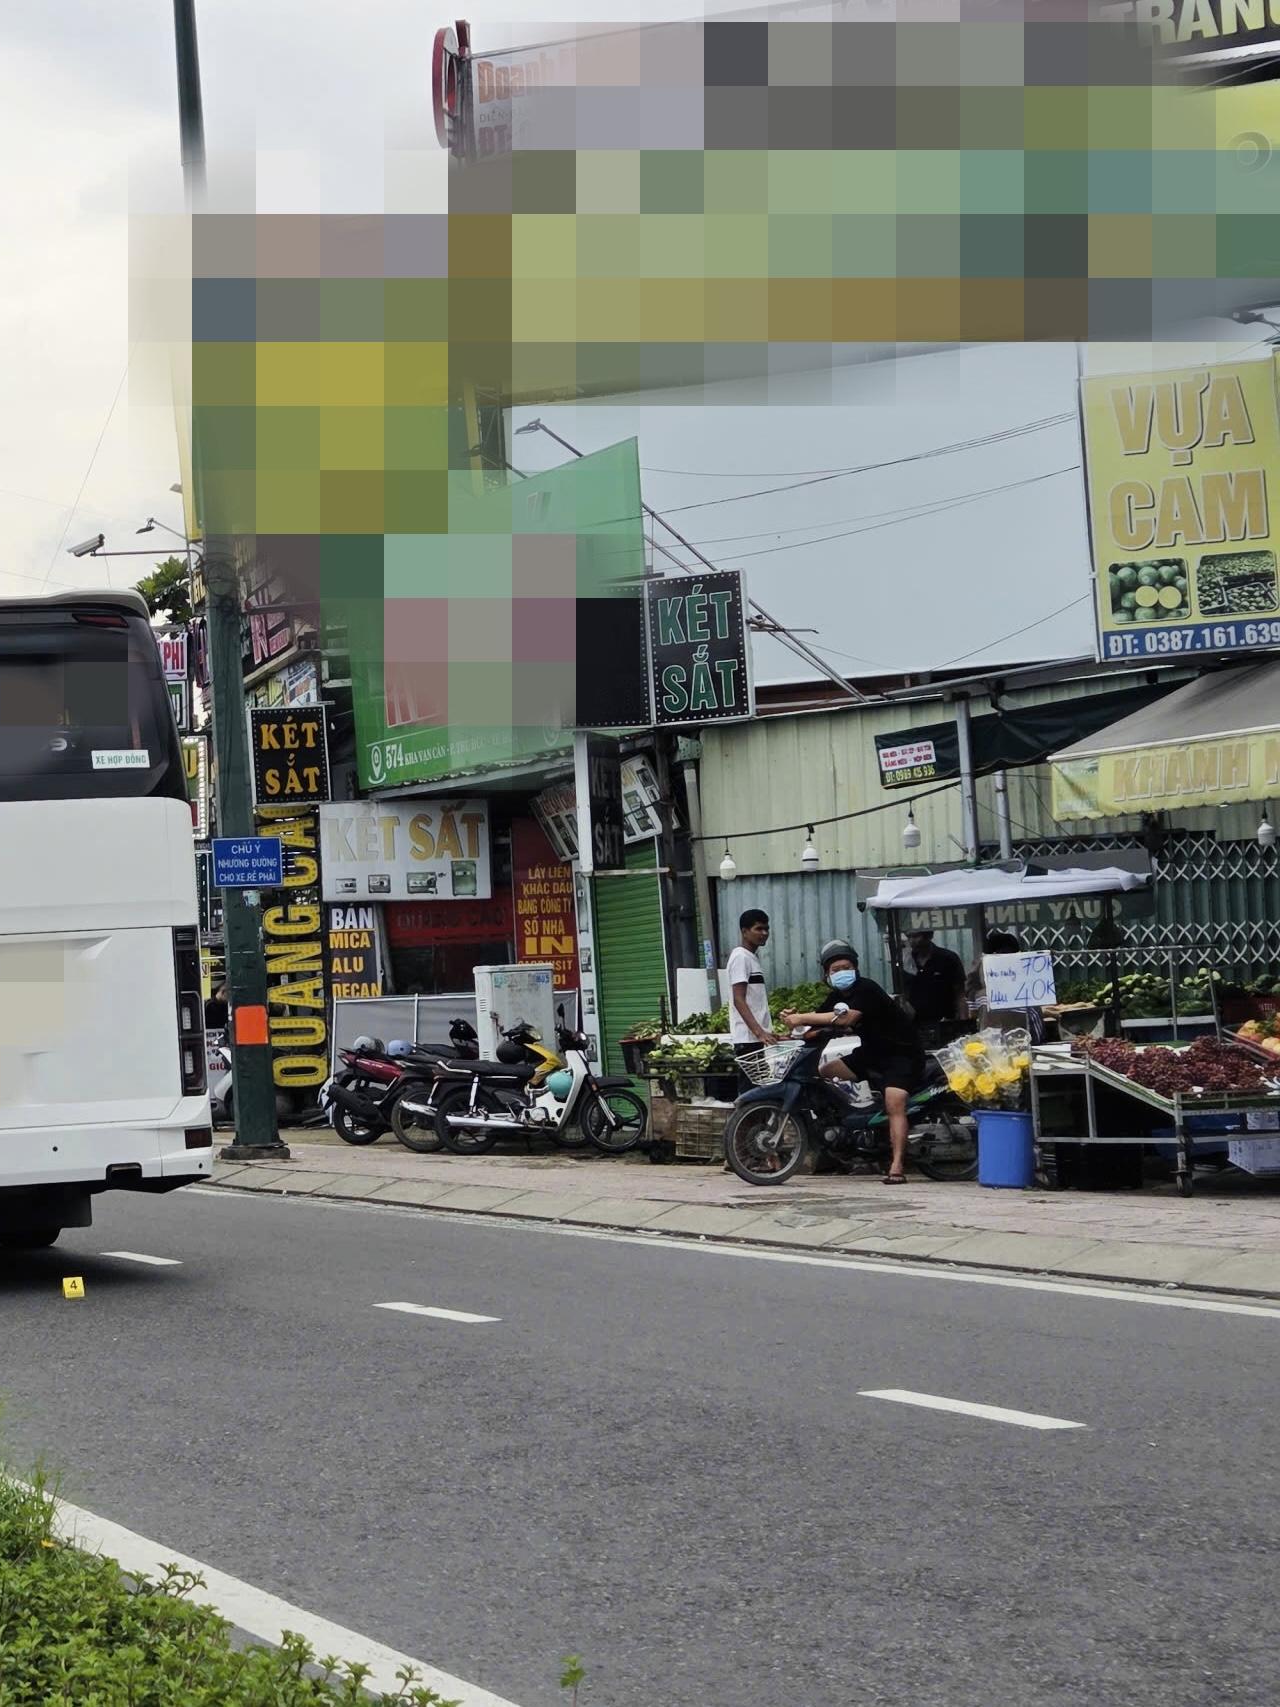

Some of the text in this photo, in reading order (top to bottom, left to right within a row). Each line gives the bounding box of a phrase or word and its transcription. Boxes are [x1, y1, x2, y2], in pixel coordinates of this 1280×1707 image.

[1110, 371, 1255, 466] VỰA
[1109, 468, 1269, 551] CAM
[657, 584, 732, 646] KÉT
[1109, 620, 1280, 656] ĐT: 0387.161.639
[662, 644, 738, 713] SẮT
[260, 715, 319, 751] KÉT
[385, 742, 404, 769] 574
[264, 753, 320, 795] SẮT
[408, 801, 485, 861] SẮT
[219, 872, 235, 883] CHO
[331, 903, 374, 930] BÁN
[329, 932, 371, 949] MICA
[525, 936, 574, 955] IN
[331, 957, 364, 973] ALU
[332, 981, 382, 998] DECAN
[70, 1280, 78, 1290] 4
